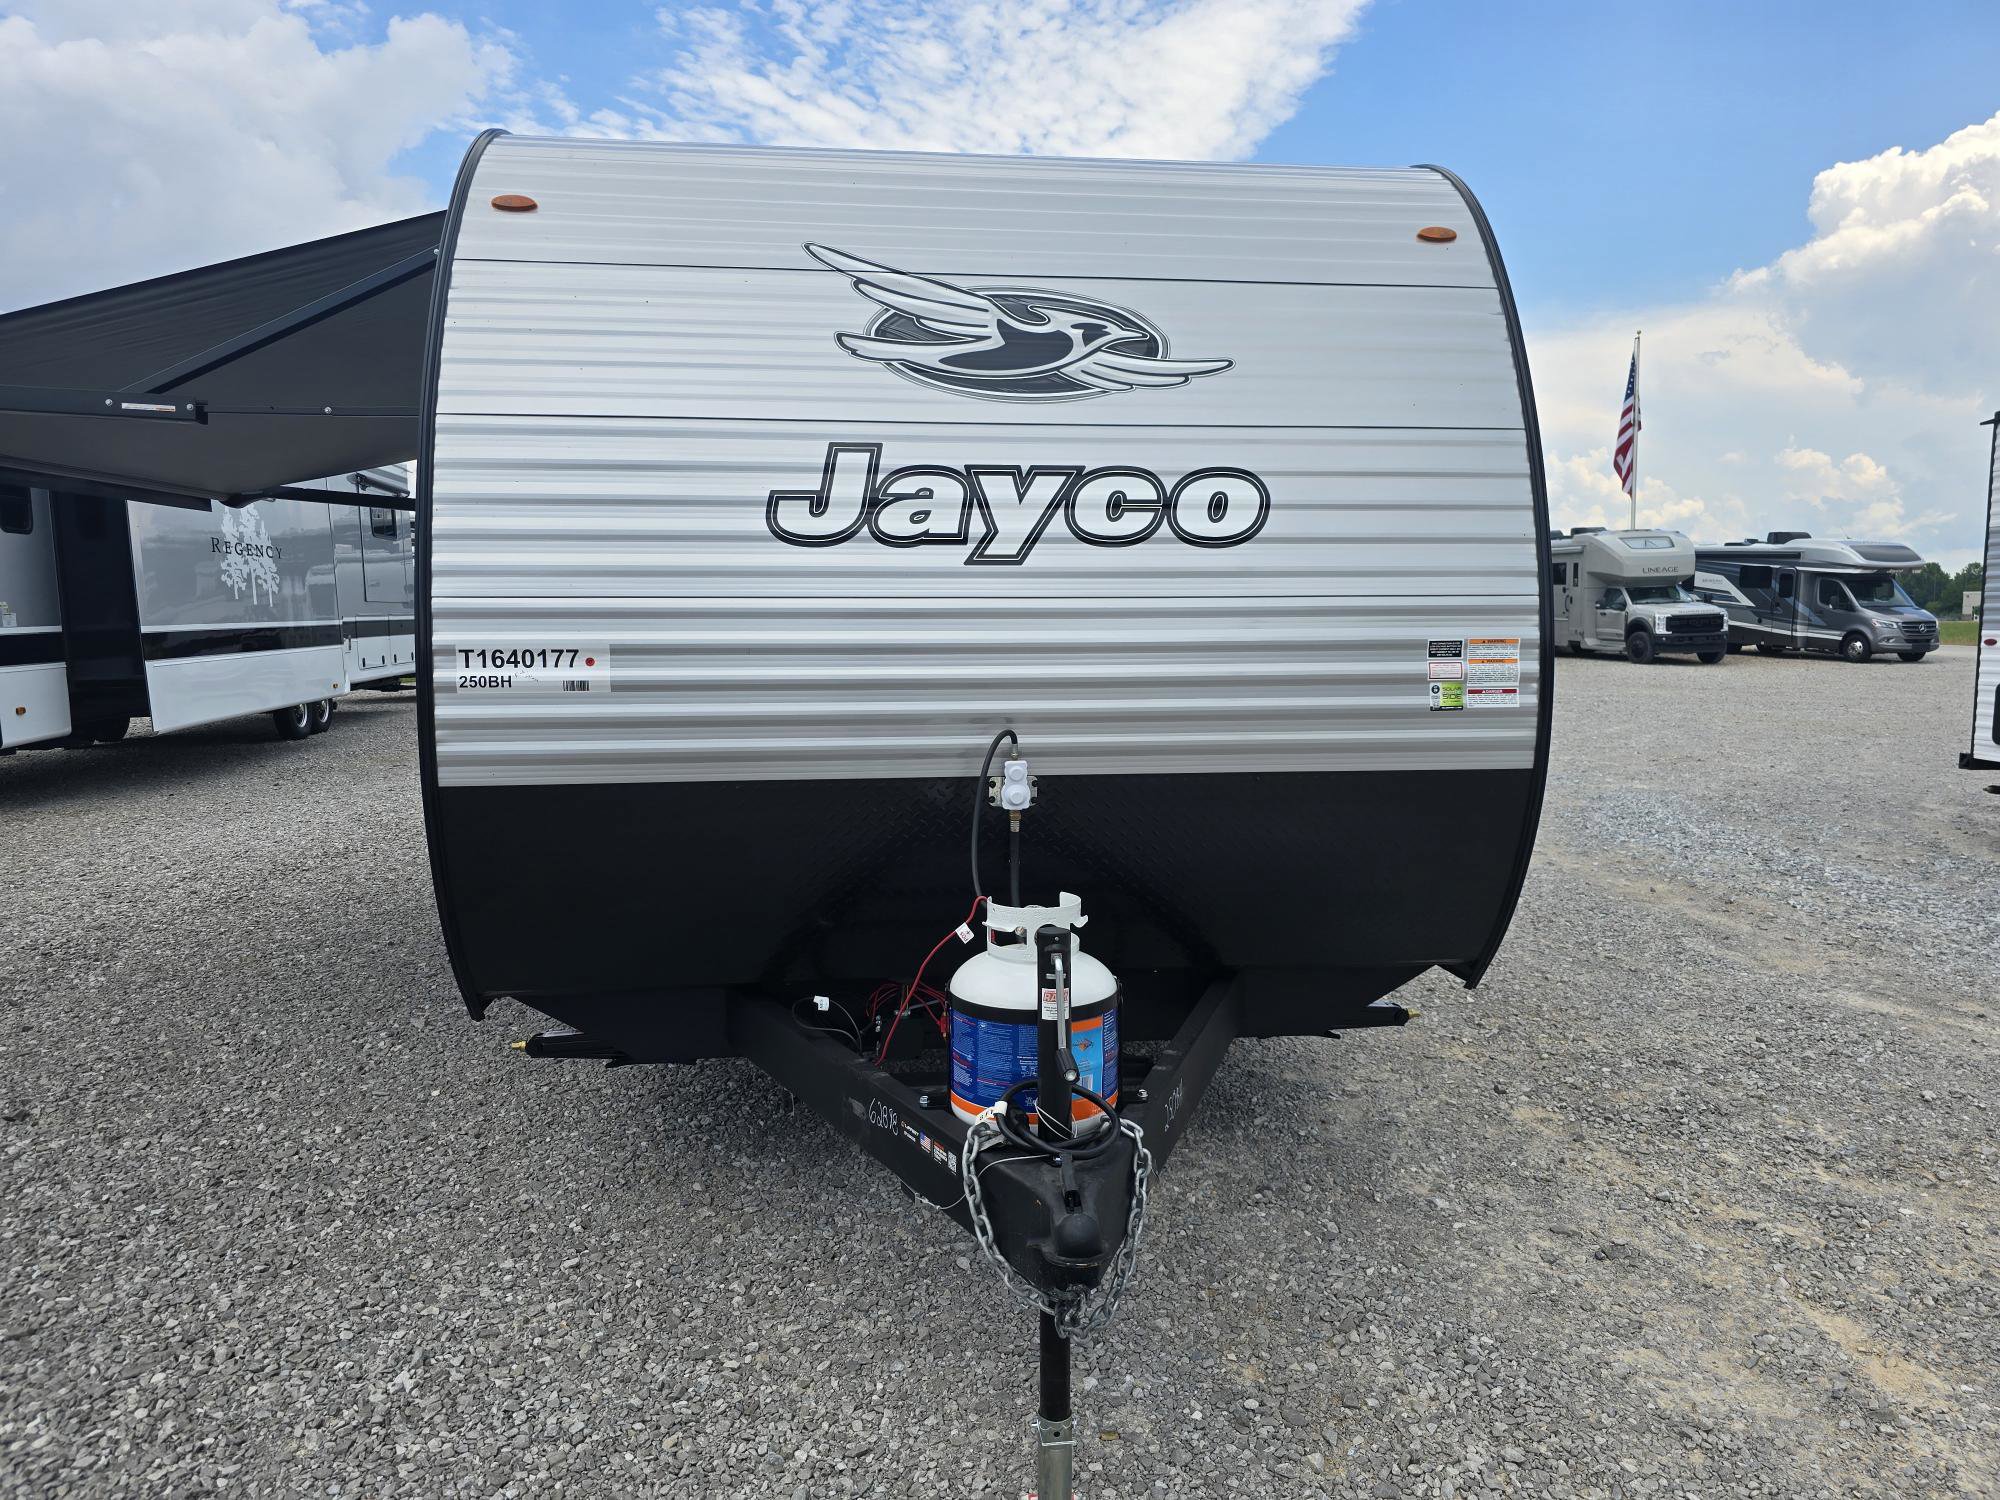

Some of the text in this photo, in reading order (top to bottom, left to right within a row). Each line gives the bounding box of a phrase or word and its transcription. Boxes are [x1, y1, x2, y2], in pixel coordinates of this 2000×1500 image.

[765, 442, 1271, 565] Jayco
[210, 537, 282, 559] REGENCY
[1642, 566, 1679, 574] LINEAGE
[458, 649, 580, 669] T1640177
[459, 675, 513, 688] 250BH
